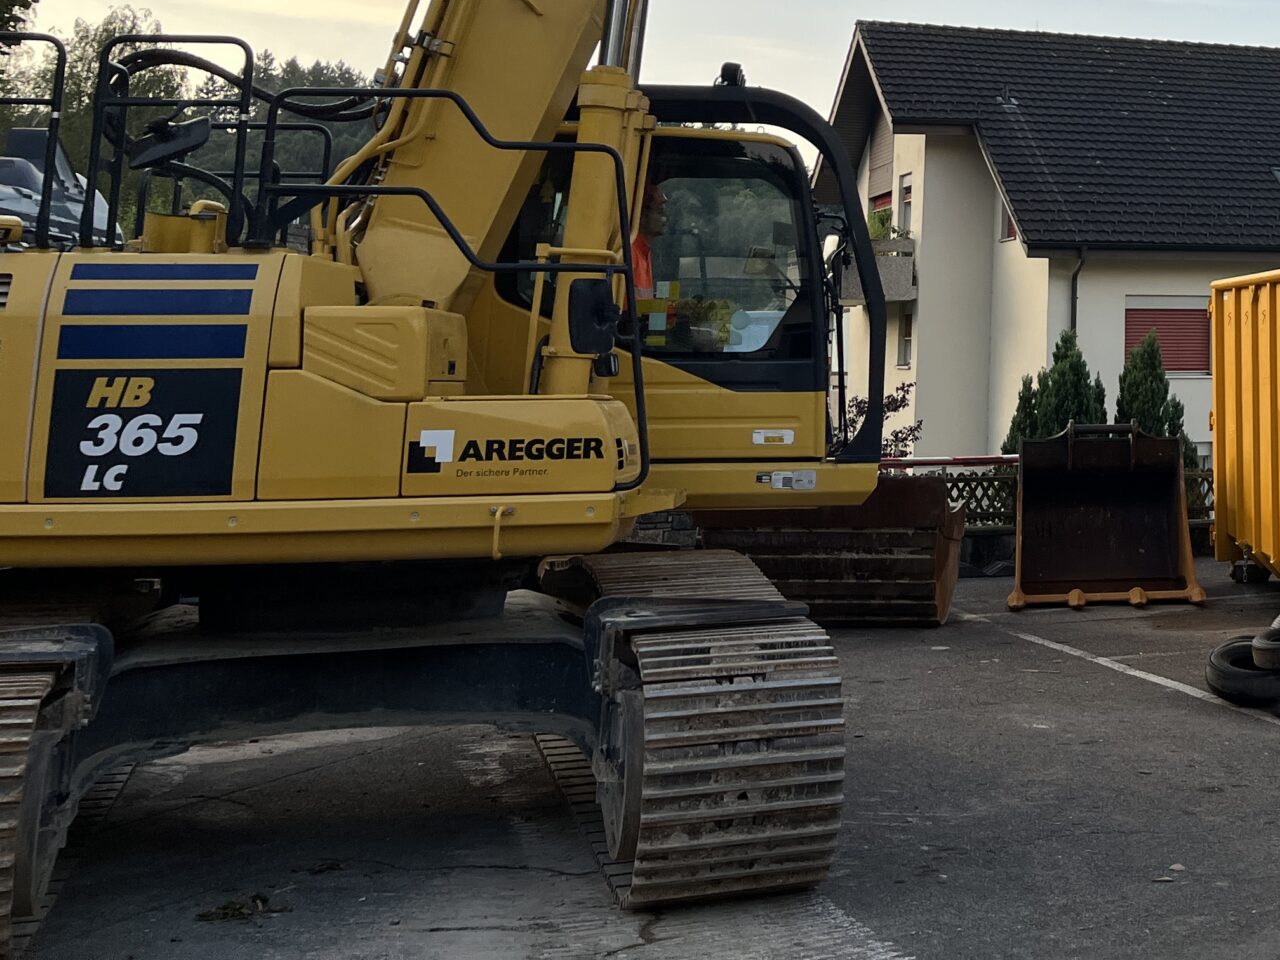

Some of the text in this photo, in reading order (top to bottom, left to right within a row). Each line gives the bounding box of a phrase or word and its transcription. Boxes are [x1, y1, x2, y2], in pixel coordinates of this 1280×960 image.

[86, 376, 155, 408] HB
[79, 413, 204, 457] 365
[458, 437, 604, 462] AREGGER
[80, 464, 129, 491] LC
[456, 468, 472, 478] Der
[475, 467, 510, 477] sichere
